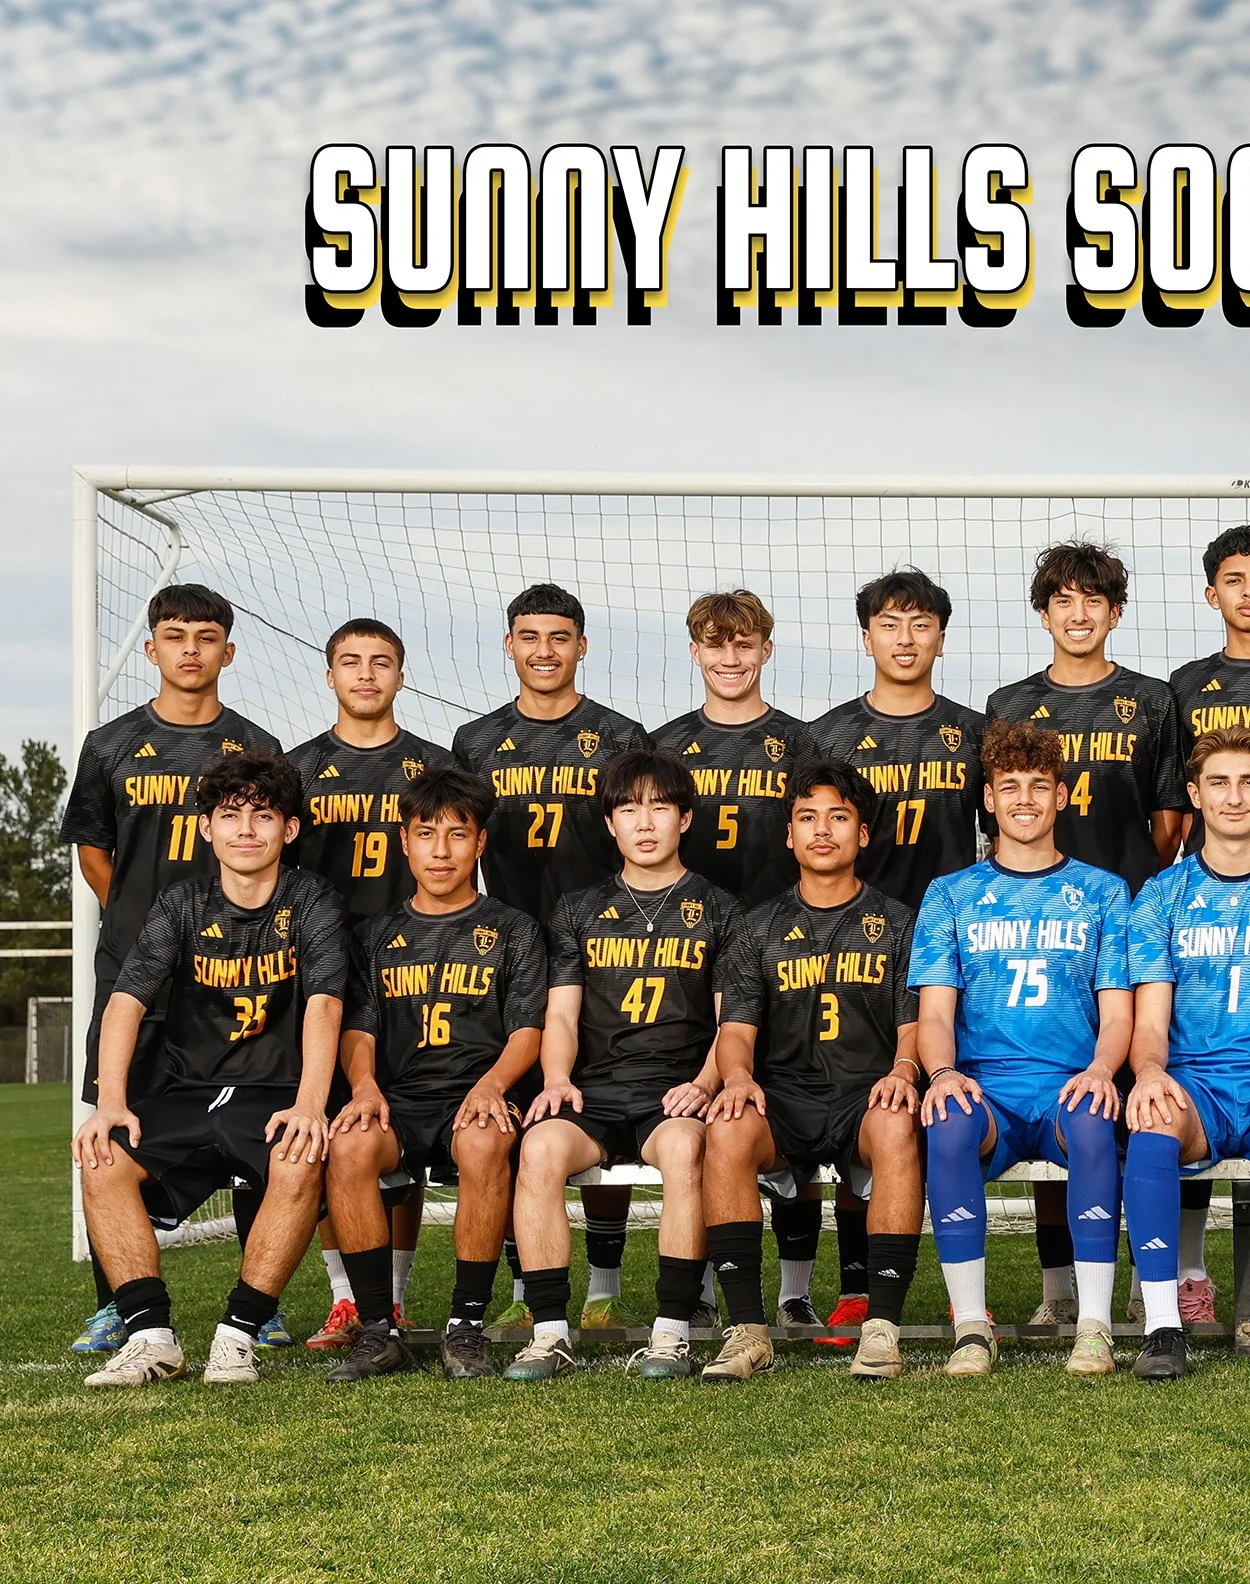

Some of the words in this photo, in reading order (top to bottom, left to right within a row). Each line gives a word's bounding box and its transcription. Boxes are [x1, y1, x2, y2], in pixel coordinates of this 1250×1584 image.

[1090, 732, 1137, 761] HILLS
[125, 775, 191, 806] SUNNY
[492, 766, 546, 797] SUNNY
[552, 766, 598, 796] HILLS
[690, 769, 732, 796] NNY
[738, 769, 787, 798] HILLS
[856, 764, 912, 793] NNY
[919, 761, 965, 789] HILLS
[1070, 771, 1092, 816] 4
[310, 794, 373, 825] SUNNY
[528, 803, 563, 847] 27
[716, 805, 738, 849] 5
[896, 799, 925, 845] 17
[168, 815, 198, 861] 11
[352, 832, 387, 877] 19
[587, 938, 650, 967] SUNNY
[654, 938, 706, 969] HILLS
[967, 920, 1028, 952] SUNNY
[1037, 920, 1087, 953] HILLS
[1178, 925, 1237, 958] SUNNY
[194, 955, 252, 987] SUNNY
[440, 963, 494, 995] HILLS
[777, 953, 830, 991] SUNNY
[836, 953, 887, 984] HILLS
[1007, 959, 1048, 1007] 75
[621, 977, 665, 1023] 47
[1228, 966, 1241, 1013] 1
[820, 993, 839, 1040] 3
